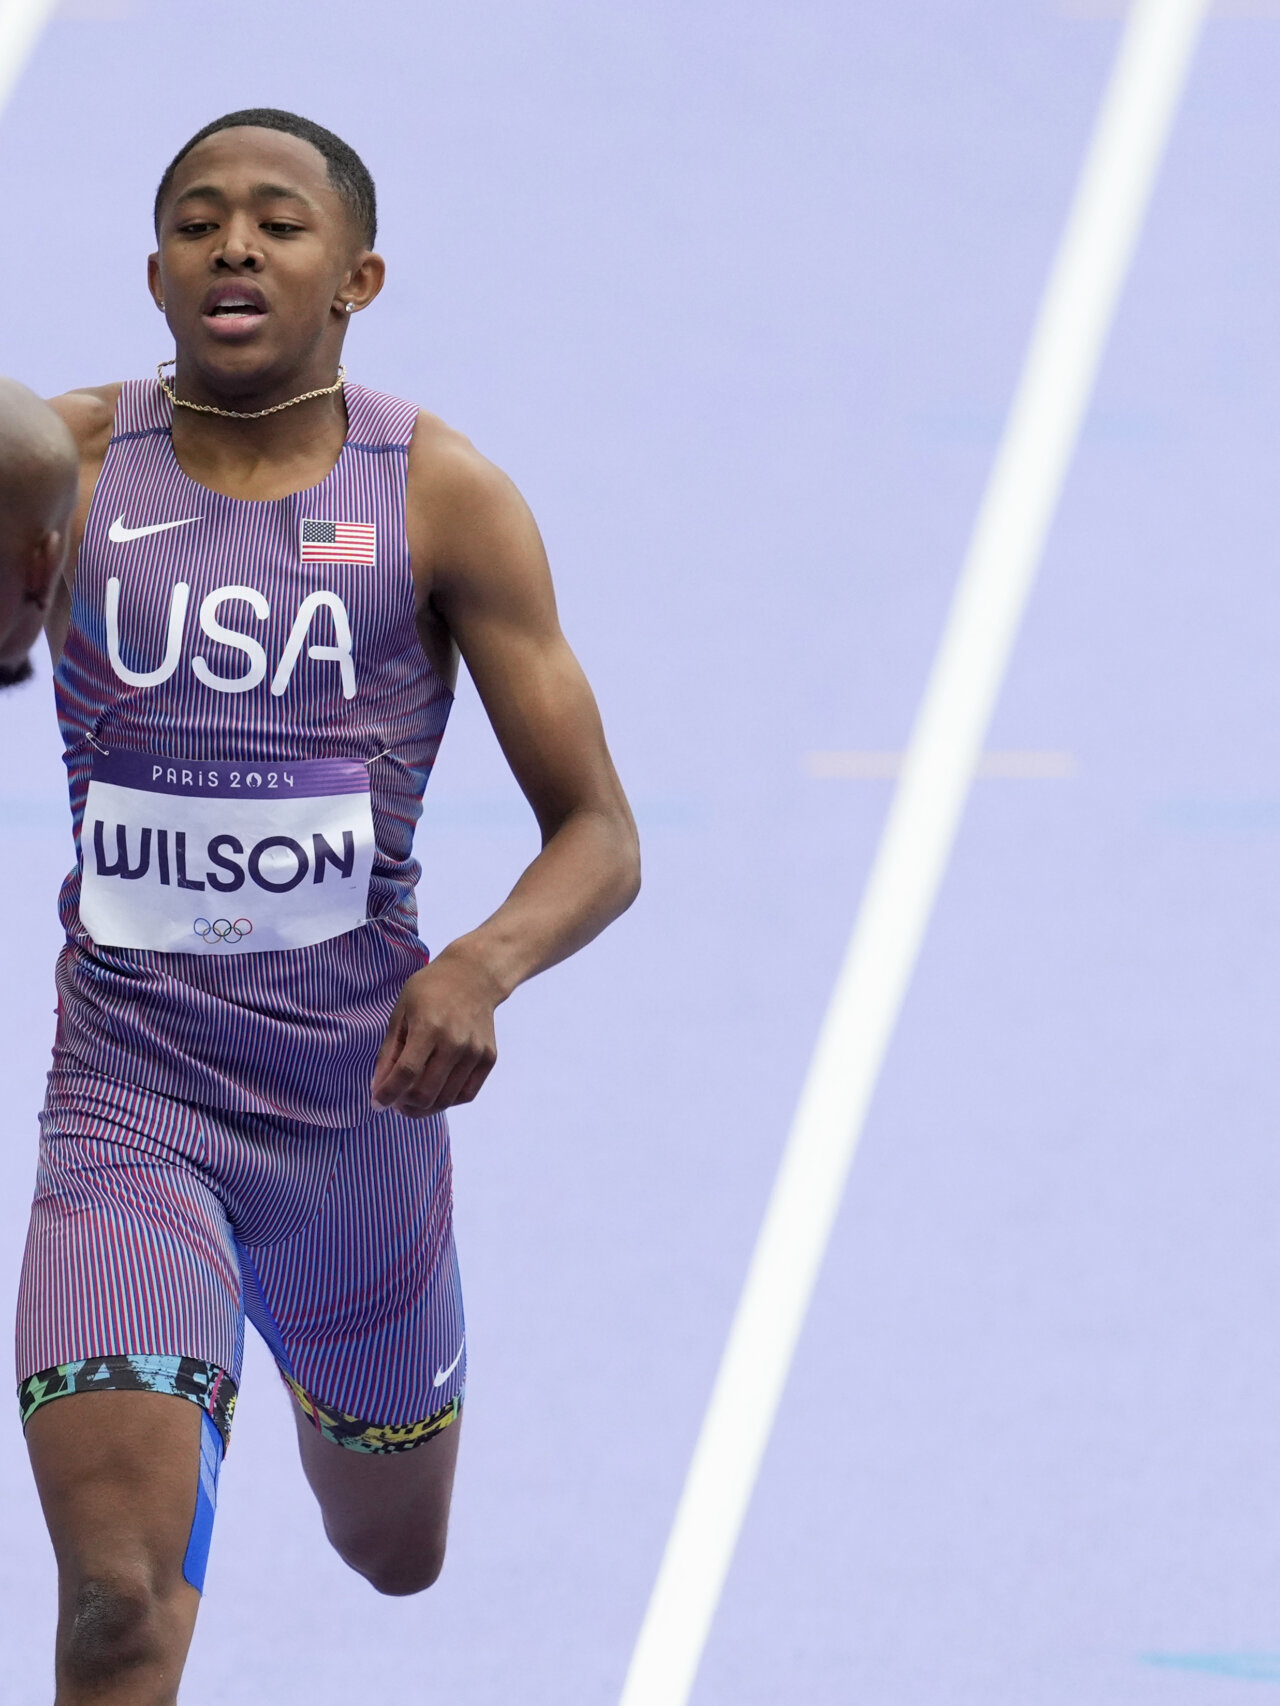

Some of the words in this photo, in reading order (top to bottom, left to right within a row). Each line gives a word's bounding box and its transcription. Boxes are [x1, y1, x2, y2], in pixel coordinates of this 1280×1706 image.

[106, 576, 357, 700] USA
[230, 771, 294, 788] 2024
[94, 819, 355, 894] WILSON
